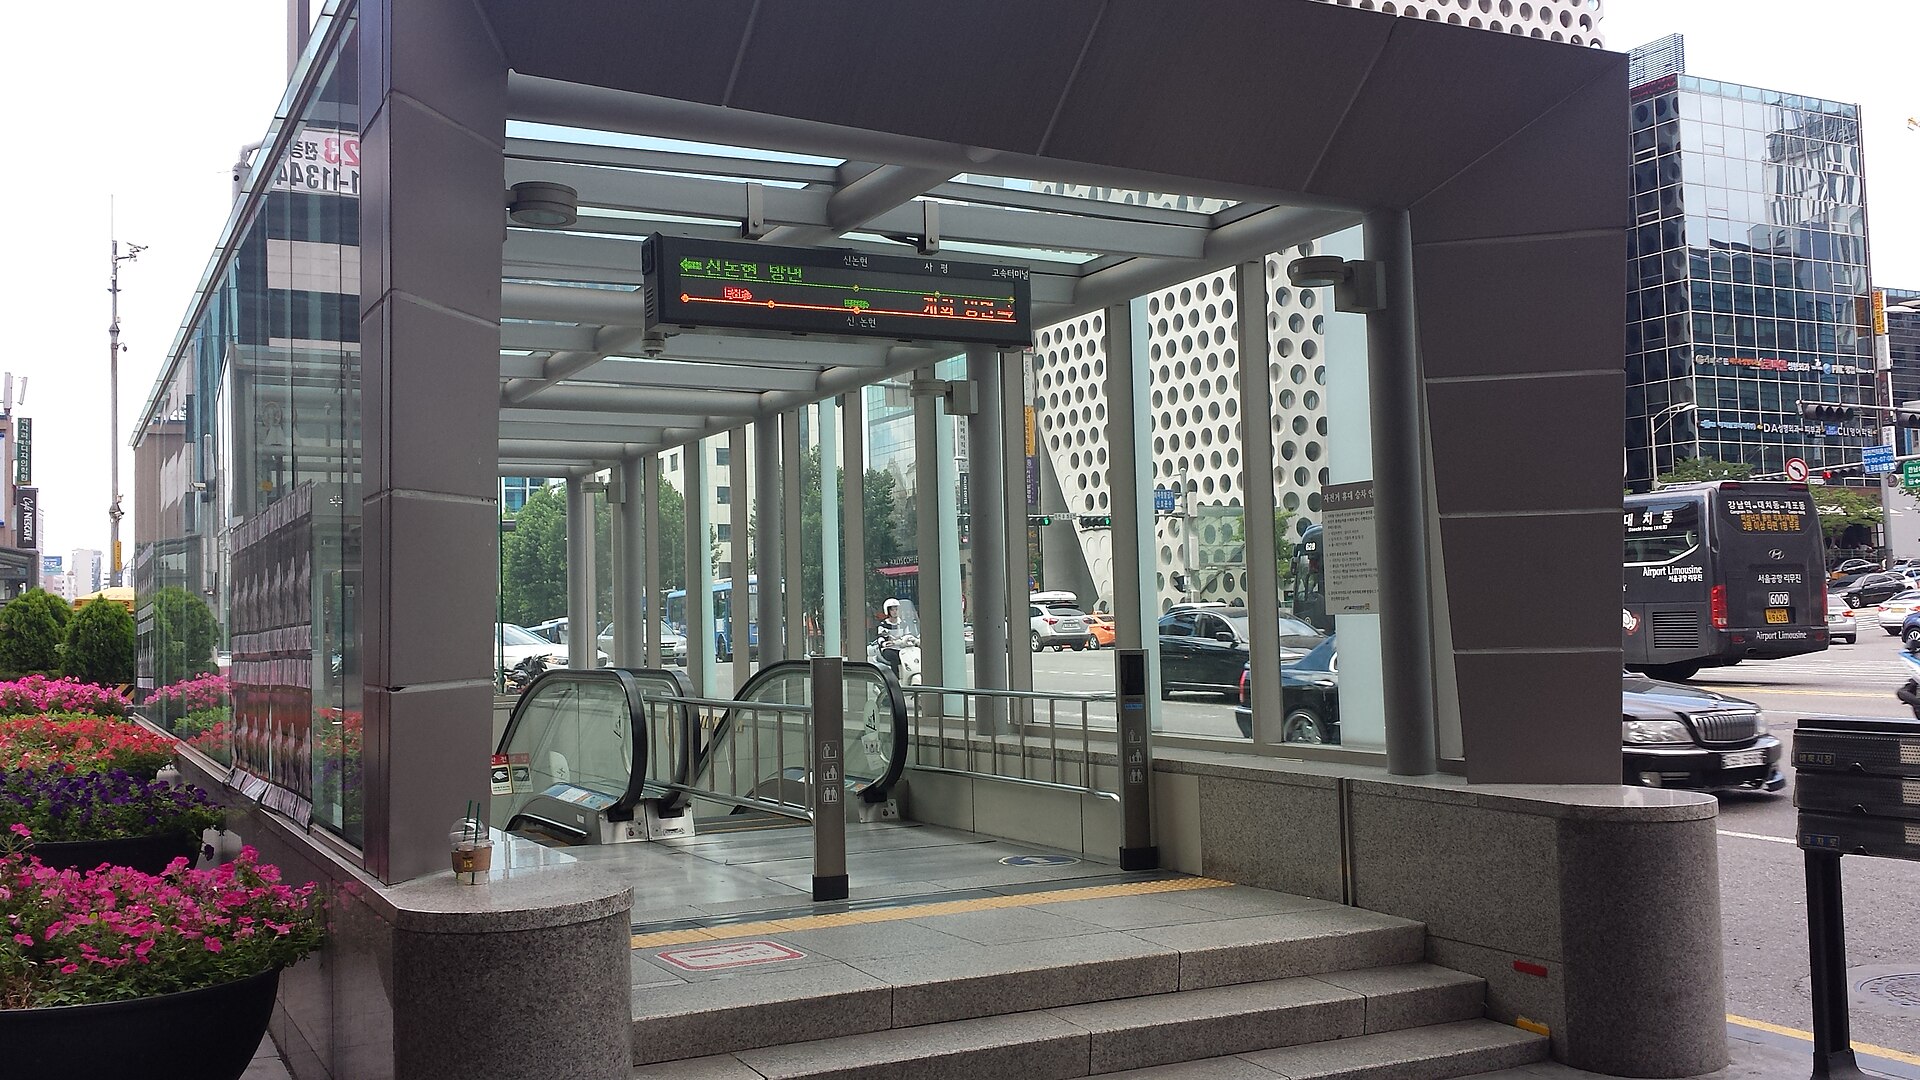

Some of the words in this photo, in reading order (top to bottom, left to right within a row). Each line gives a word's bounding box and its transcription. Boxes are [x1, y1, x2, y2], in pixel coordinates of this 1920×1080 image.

[842, 255, 869, 268] 신논현
[992, 267, 1029, 281] 고속터미널
[1642, 567, 1667, 579] Airport
[1667, 565, 1703, 576] Limousine
[1757, 574, 1783, 584] 서울공항
[1783, 573, 1802, 584] 리무진
[1770, 593, 1789, 605] 6009
[1756, 631, 1777, 642] Airport
[1777, 630, 1807, 640] Limousine
[1799, 753, 1832, 765] 벼룩시장
